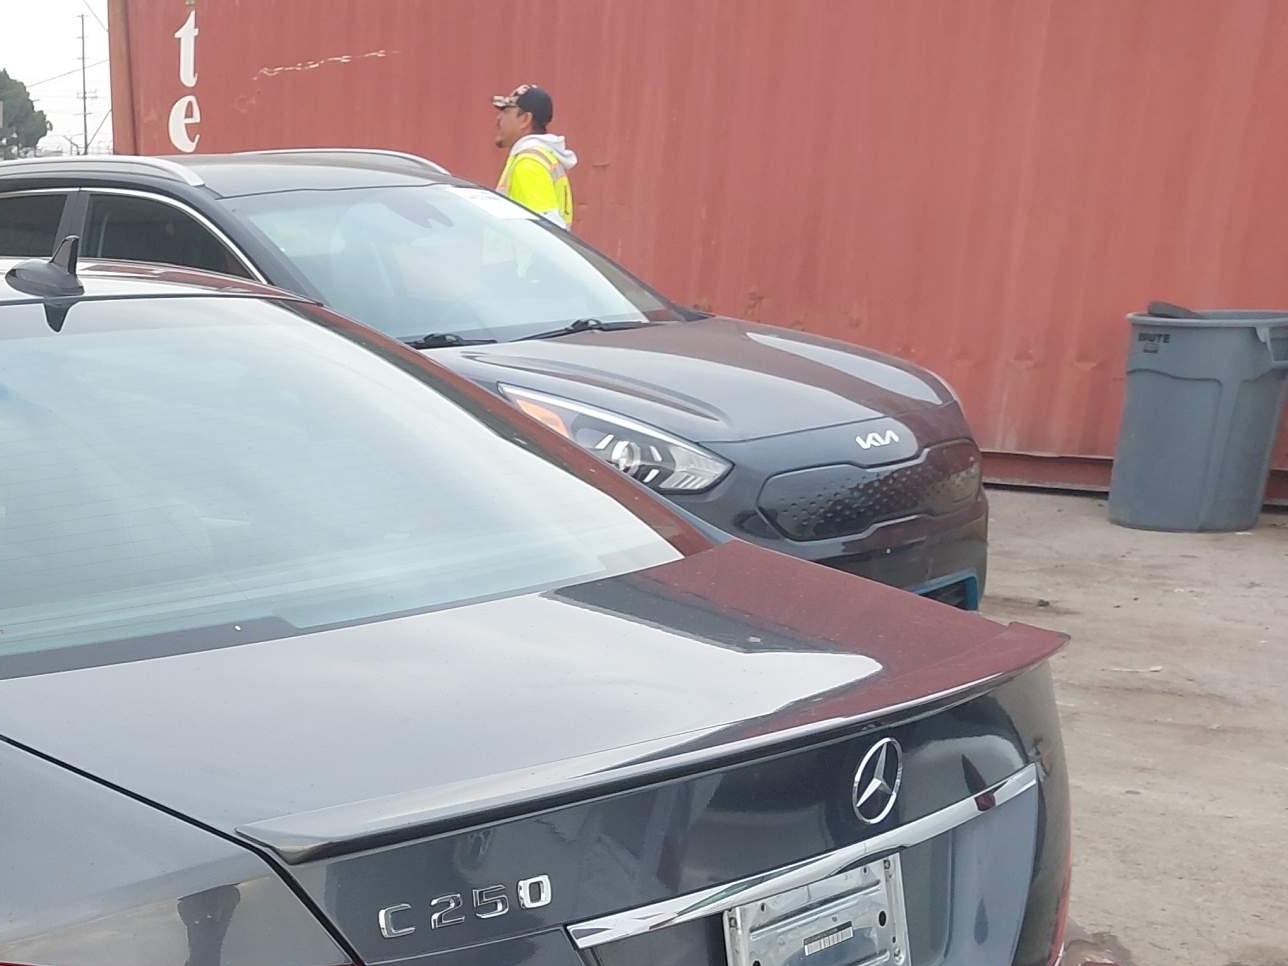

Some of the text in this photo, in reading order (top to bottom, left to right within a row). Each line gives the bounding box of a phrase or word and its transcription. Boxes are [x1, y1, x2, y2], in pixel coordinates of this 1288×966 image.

[855, 430, 900, 449] KIA
[378, 874, 553, 939] C 250
